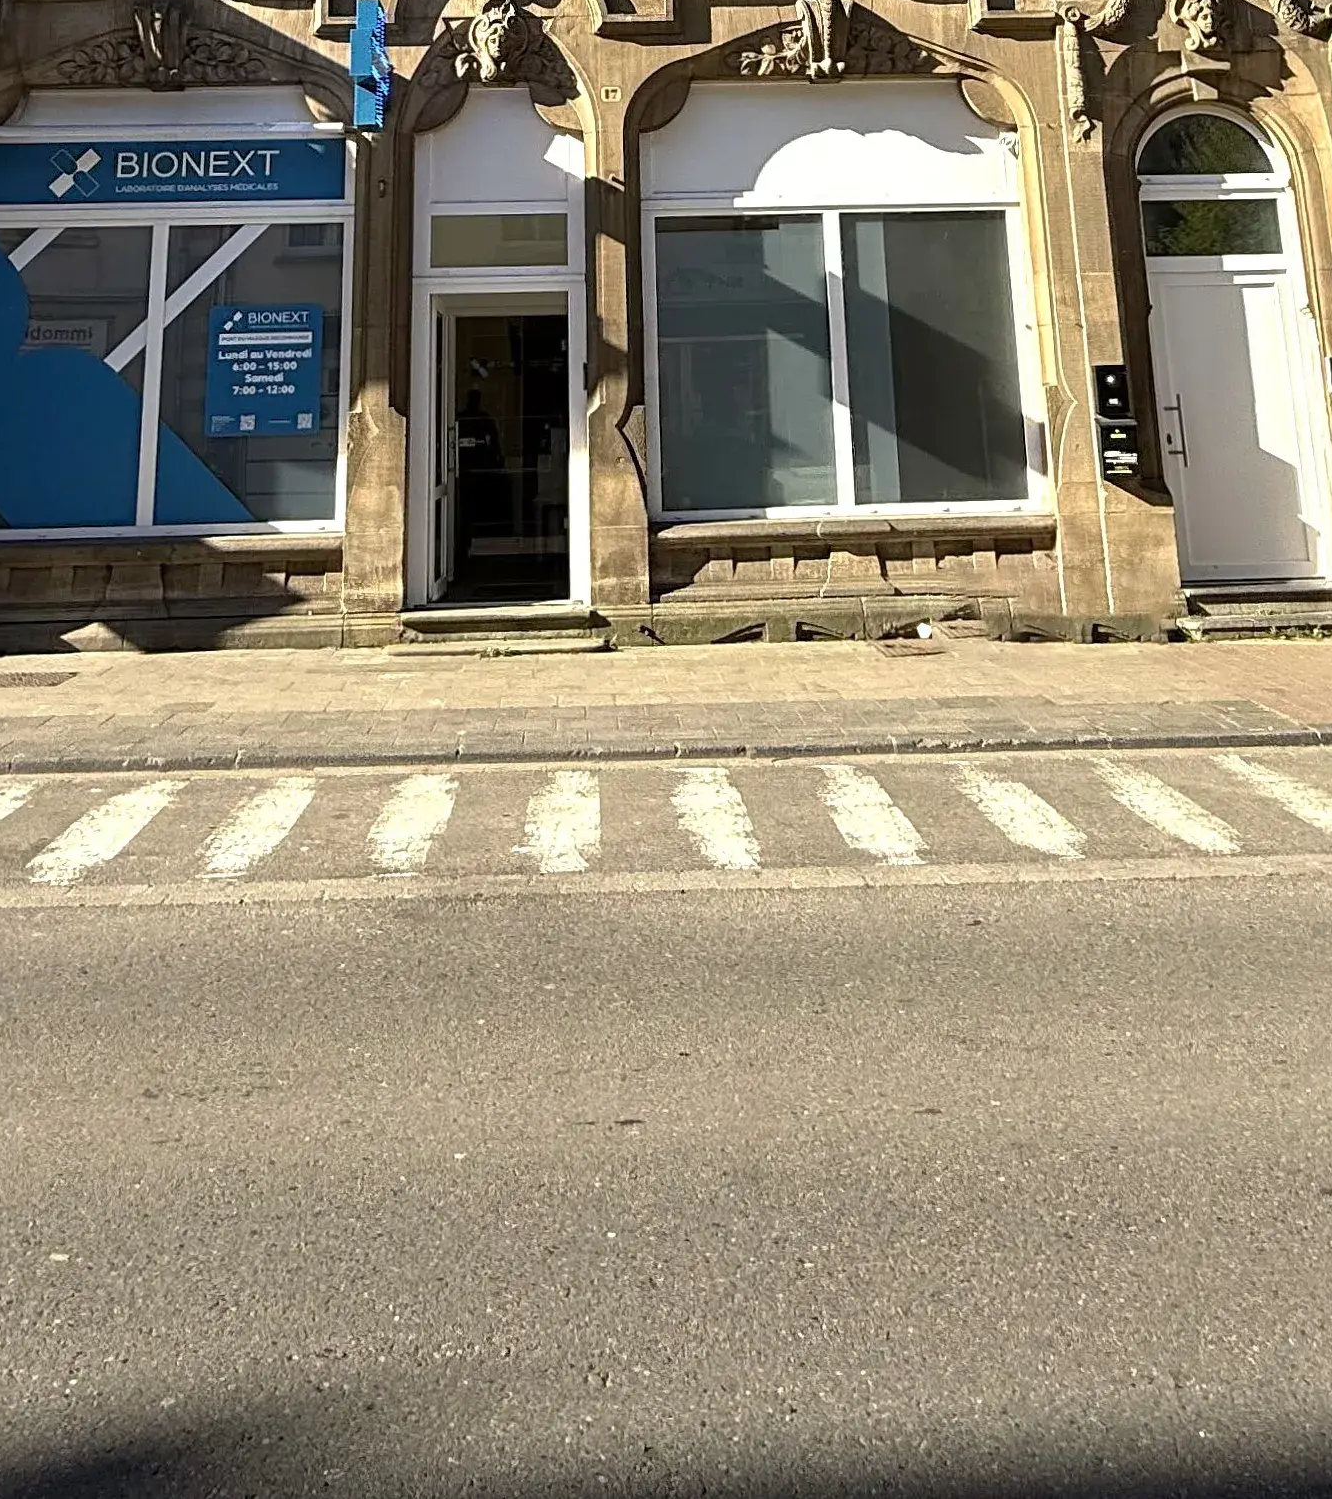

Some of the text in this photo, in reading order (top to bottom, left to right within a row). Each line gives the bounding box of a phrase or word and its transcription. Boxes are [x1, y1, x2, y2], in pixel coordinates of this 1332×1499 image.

[604, 88, 618, 99] 17
[116, 150, 280, 178] BIONEXT
[248, 311, 309, 323] BIONEXT
[218, 350, 248, 359] Lundi
[265, 348, 312, 359] Vendredi
[232, 362, 257, 371] 6:00
[267, 361, 297, 371] 15:00
[245, 372, 284, 383] Samedi
[232, 386, 256, 395] 7:00
[266, 385, 295, 395] 12:00
